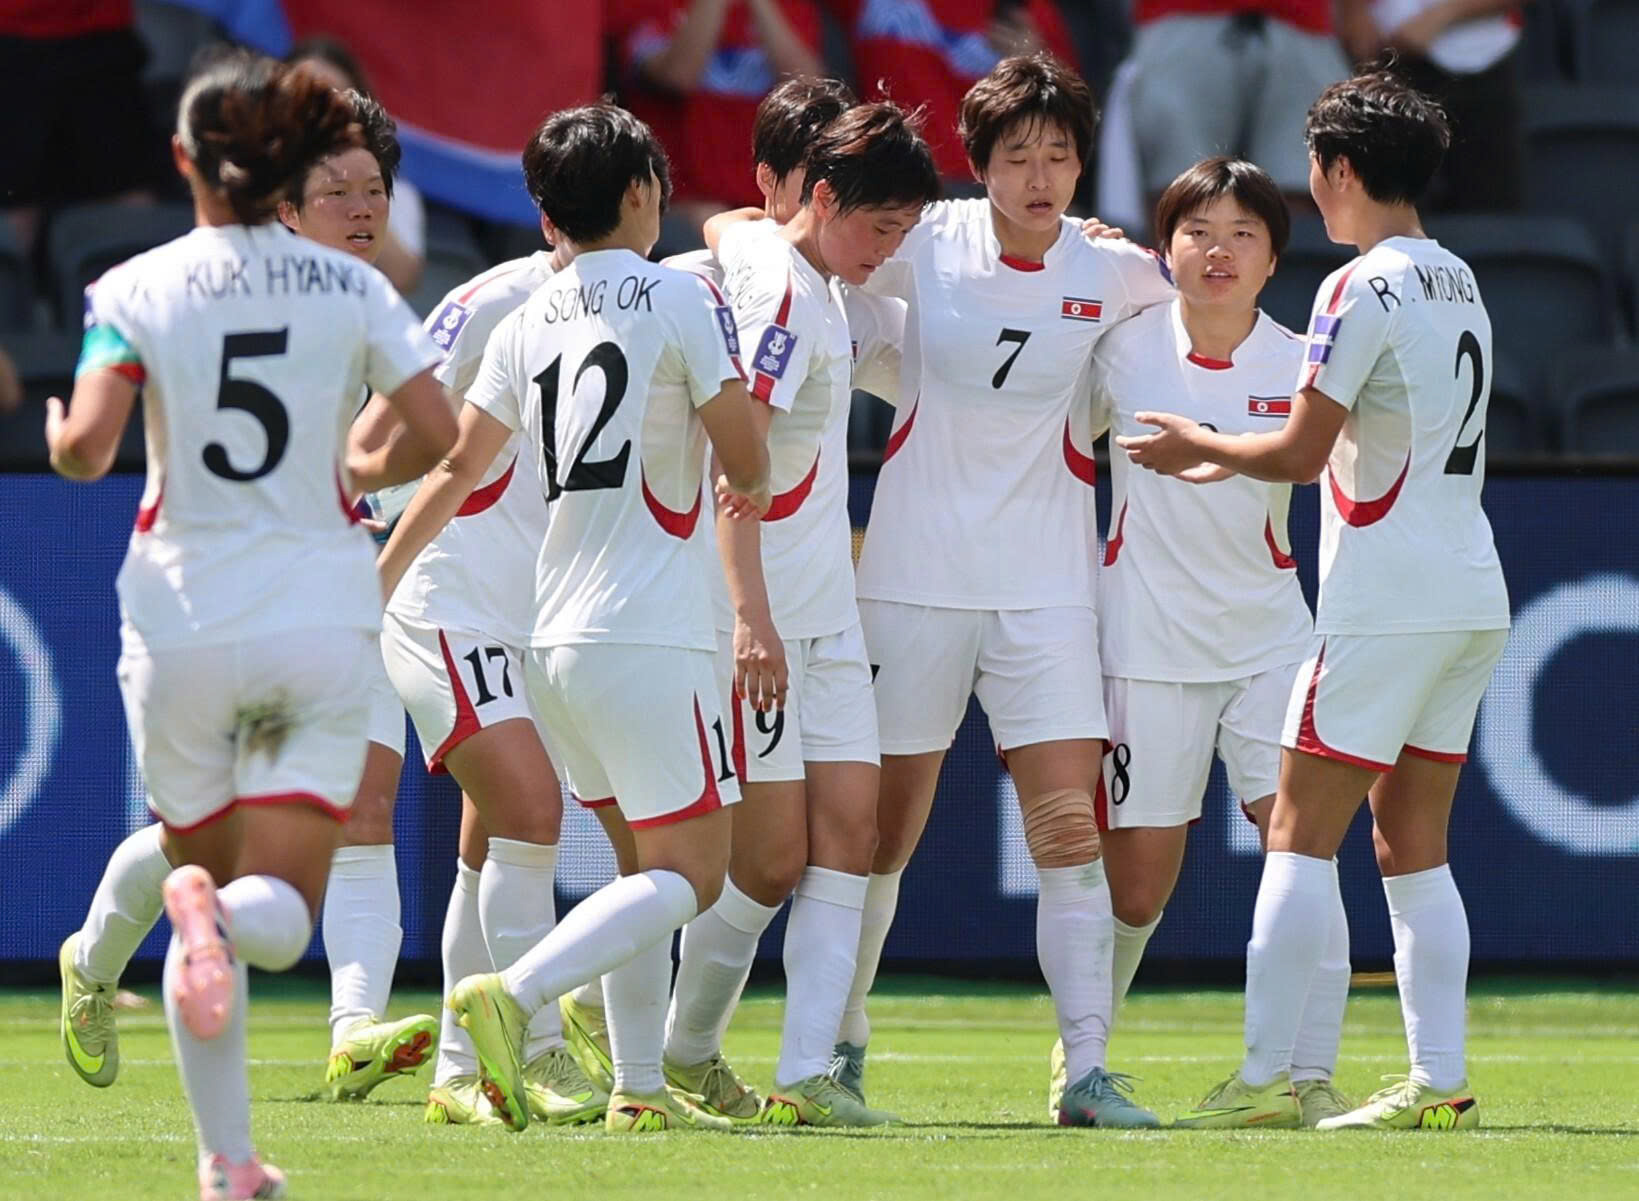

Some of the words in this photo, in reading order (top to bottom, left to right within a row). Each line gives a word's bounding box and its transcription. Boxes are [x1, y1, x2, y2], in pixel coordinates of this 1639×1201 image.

[185, 258, 252, 299] KUK
[545, 280, 607, 324] SONG
[617, 276, 661, 312] OK
[1414, 264, 1475, 304] MYONG
[992, 327, 1032, 389] 7
[202, 326, 289, 482] 5
[532, 341, 632, 502] 12
[1443, 330, 1484, 475] 2
[463, 646, 514, 707] 17
[1111, 743, 1132, 806] 8
